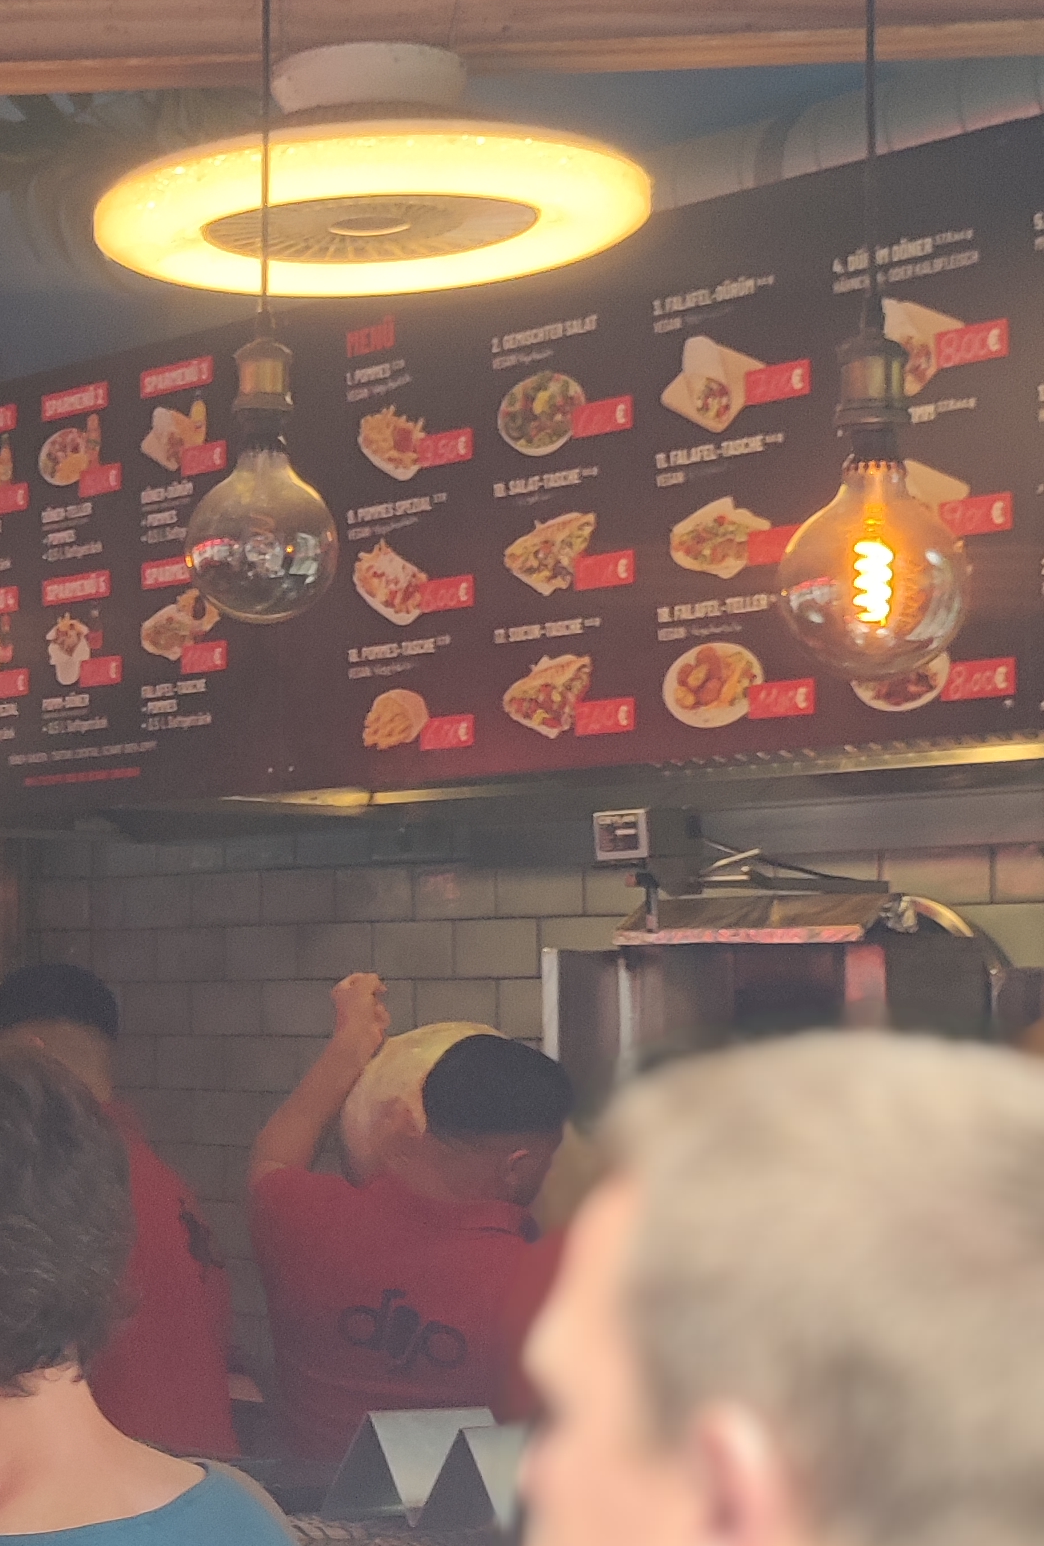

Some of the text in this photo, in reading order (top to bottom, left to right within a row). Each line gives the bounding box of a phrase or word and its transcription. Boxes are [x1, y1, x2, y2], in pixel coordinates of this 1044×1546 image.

[892, 238, 933, 261] DÖNER
[665, 276, 755, 313] FALAFEL-DÜRÜM
[346, 315, 396, 358] MENÜ
[502, 322, 563, 350] GEMISCHTER
[565, 313, 598, 336] SALAT
[354, 363, 392, 384] POMMES
[669, 434, 764, 466] FALAFEL-TASCHE
[508, 467, 582, 495] SALAT-TASCHE
[674, 594, 768, 621] FALAFEL-TELLER
